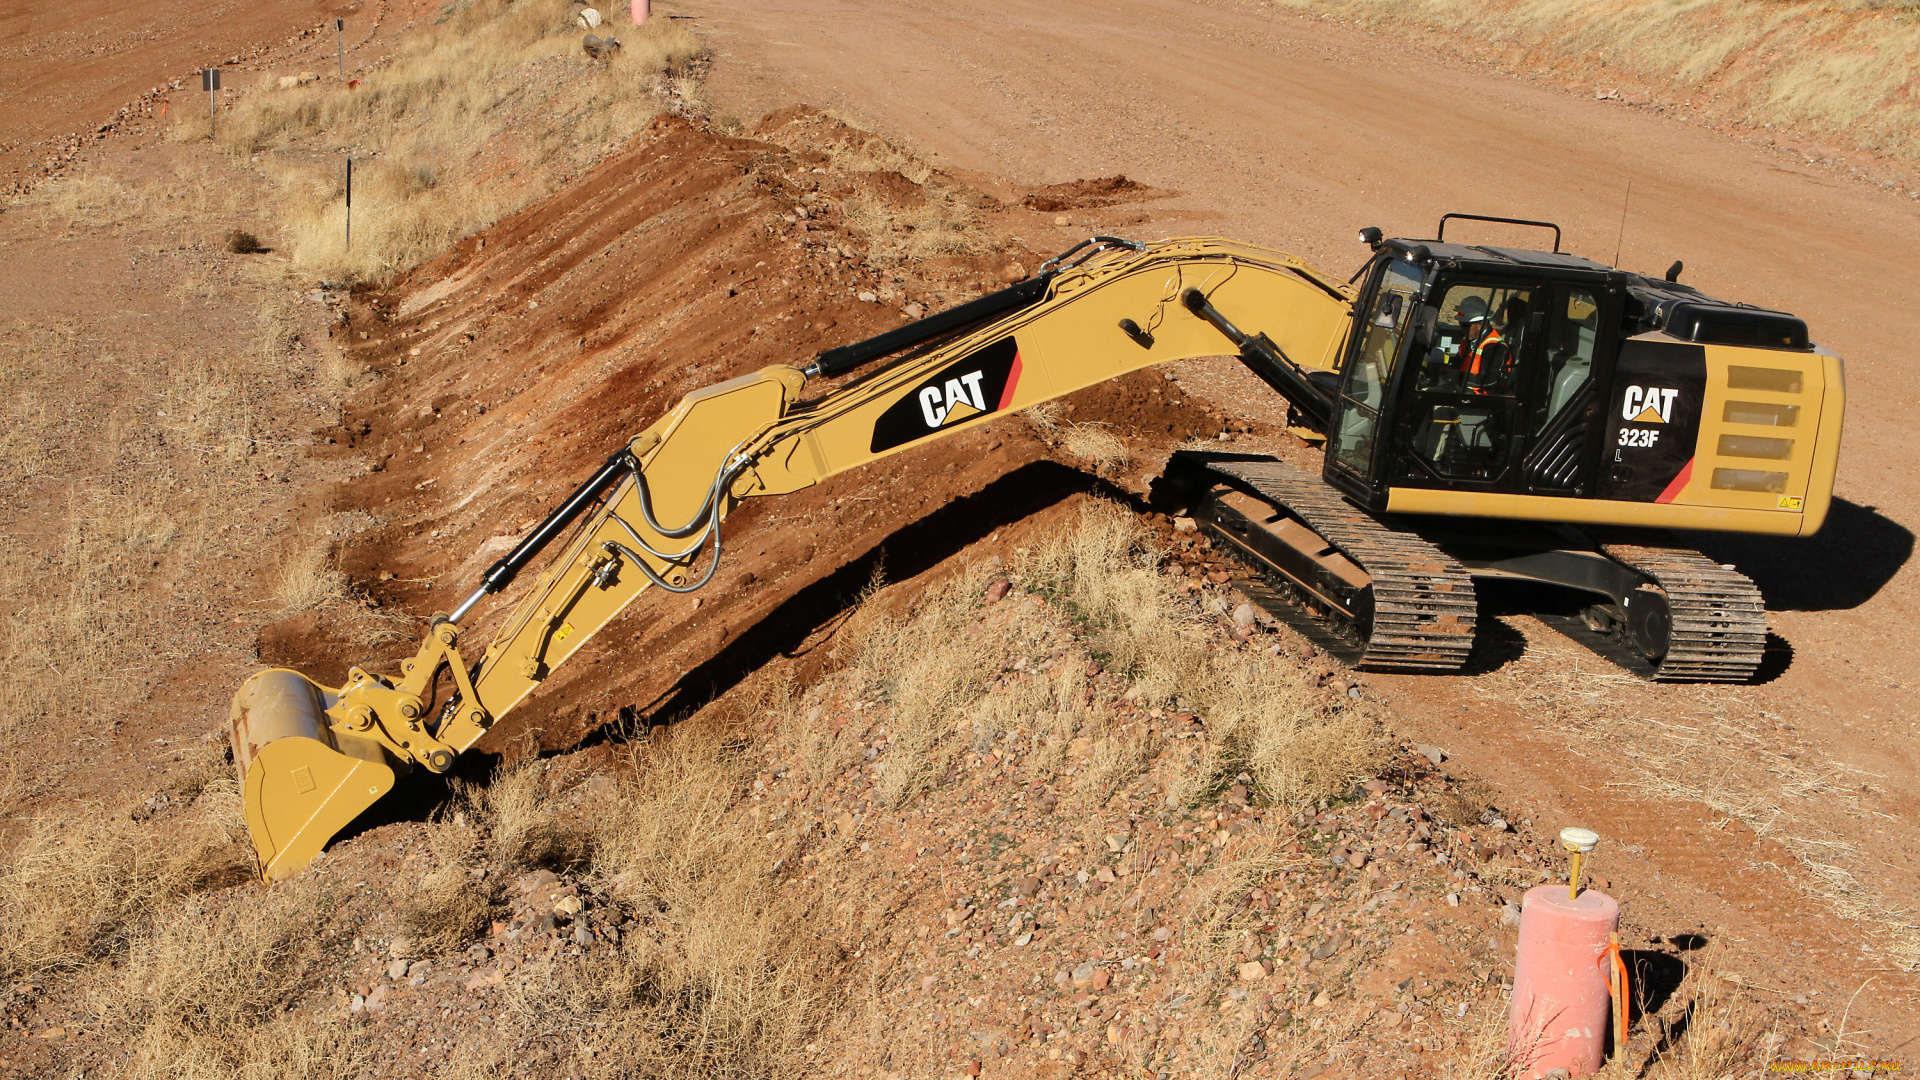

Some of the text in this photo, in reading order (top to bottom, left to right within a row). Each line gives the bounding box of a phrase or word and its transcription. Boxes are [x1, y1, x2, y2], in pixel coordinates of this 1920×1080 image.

[919, 370, 986, 427] CAT
[1622, 385, 1678, 423] CAT
[1618, 428, 1659, 447] 323F
[1614, 448, 1622, 462] L
